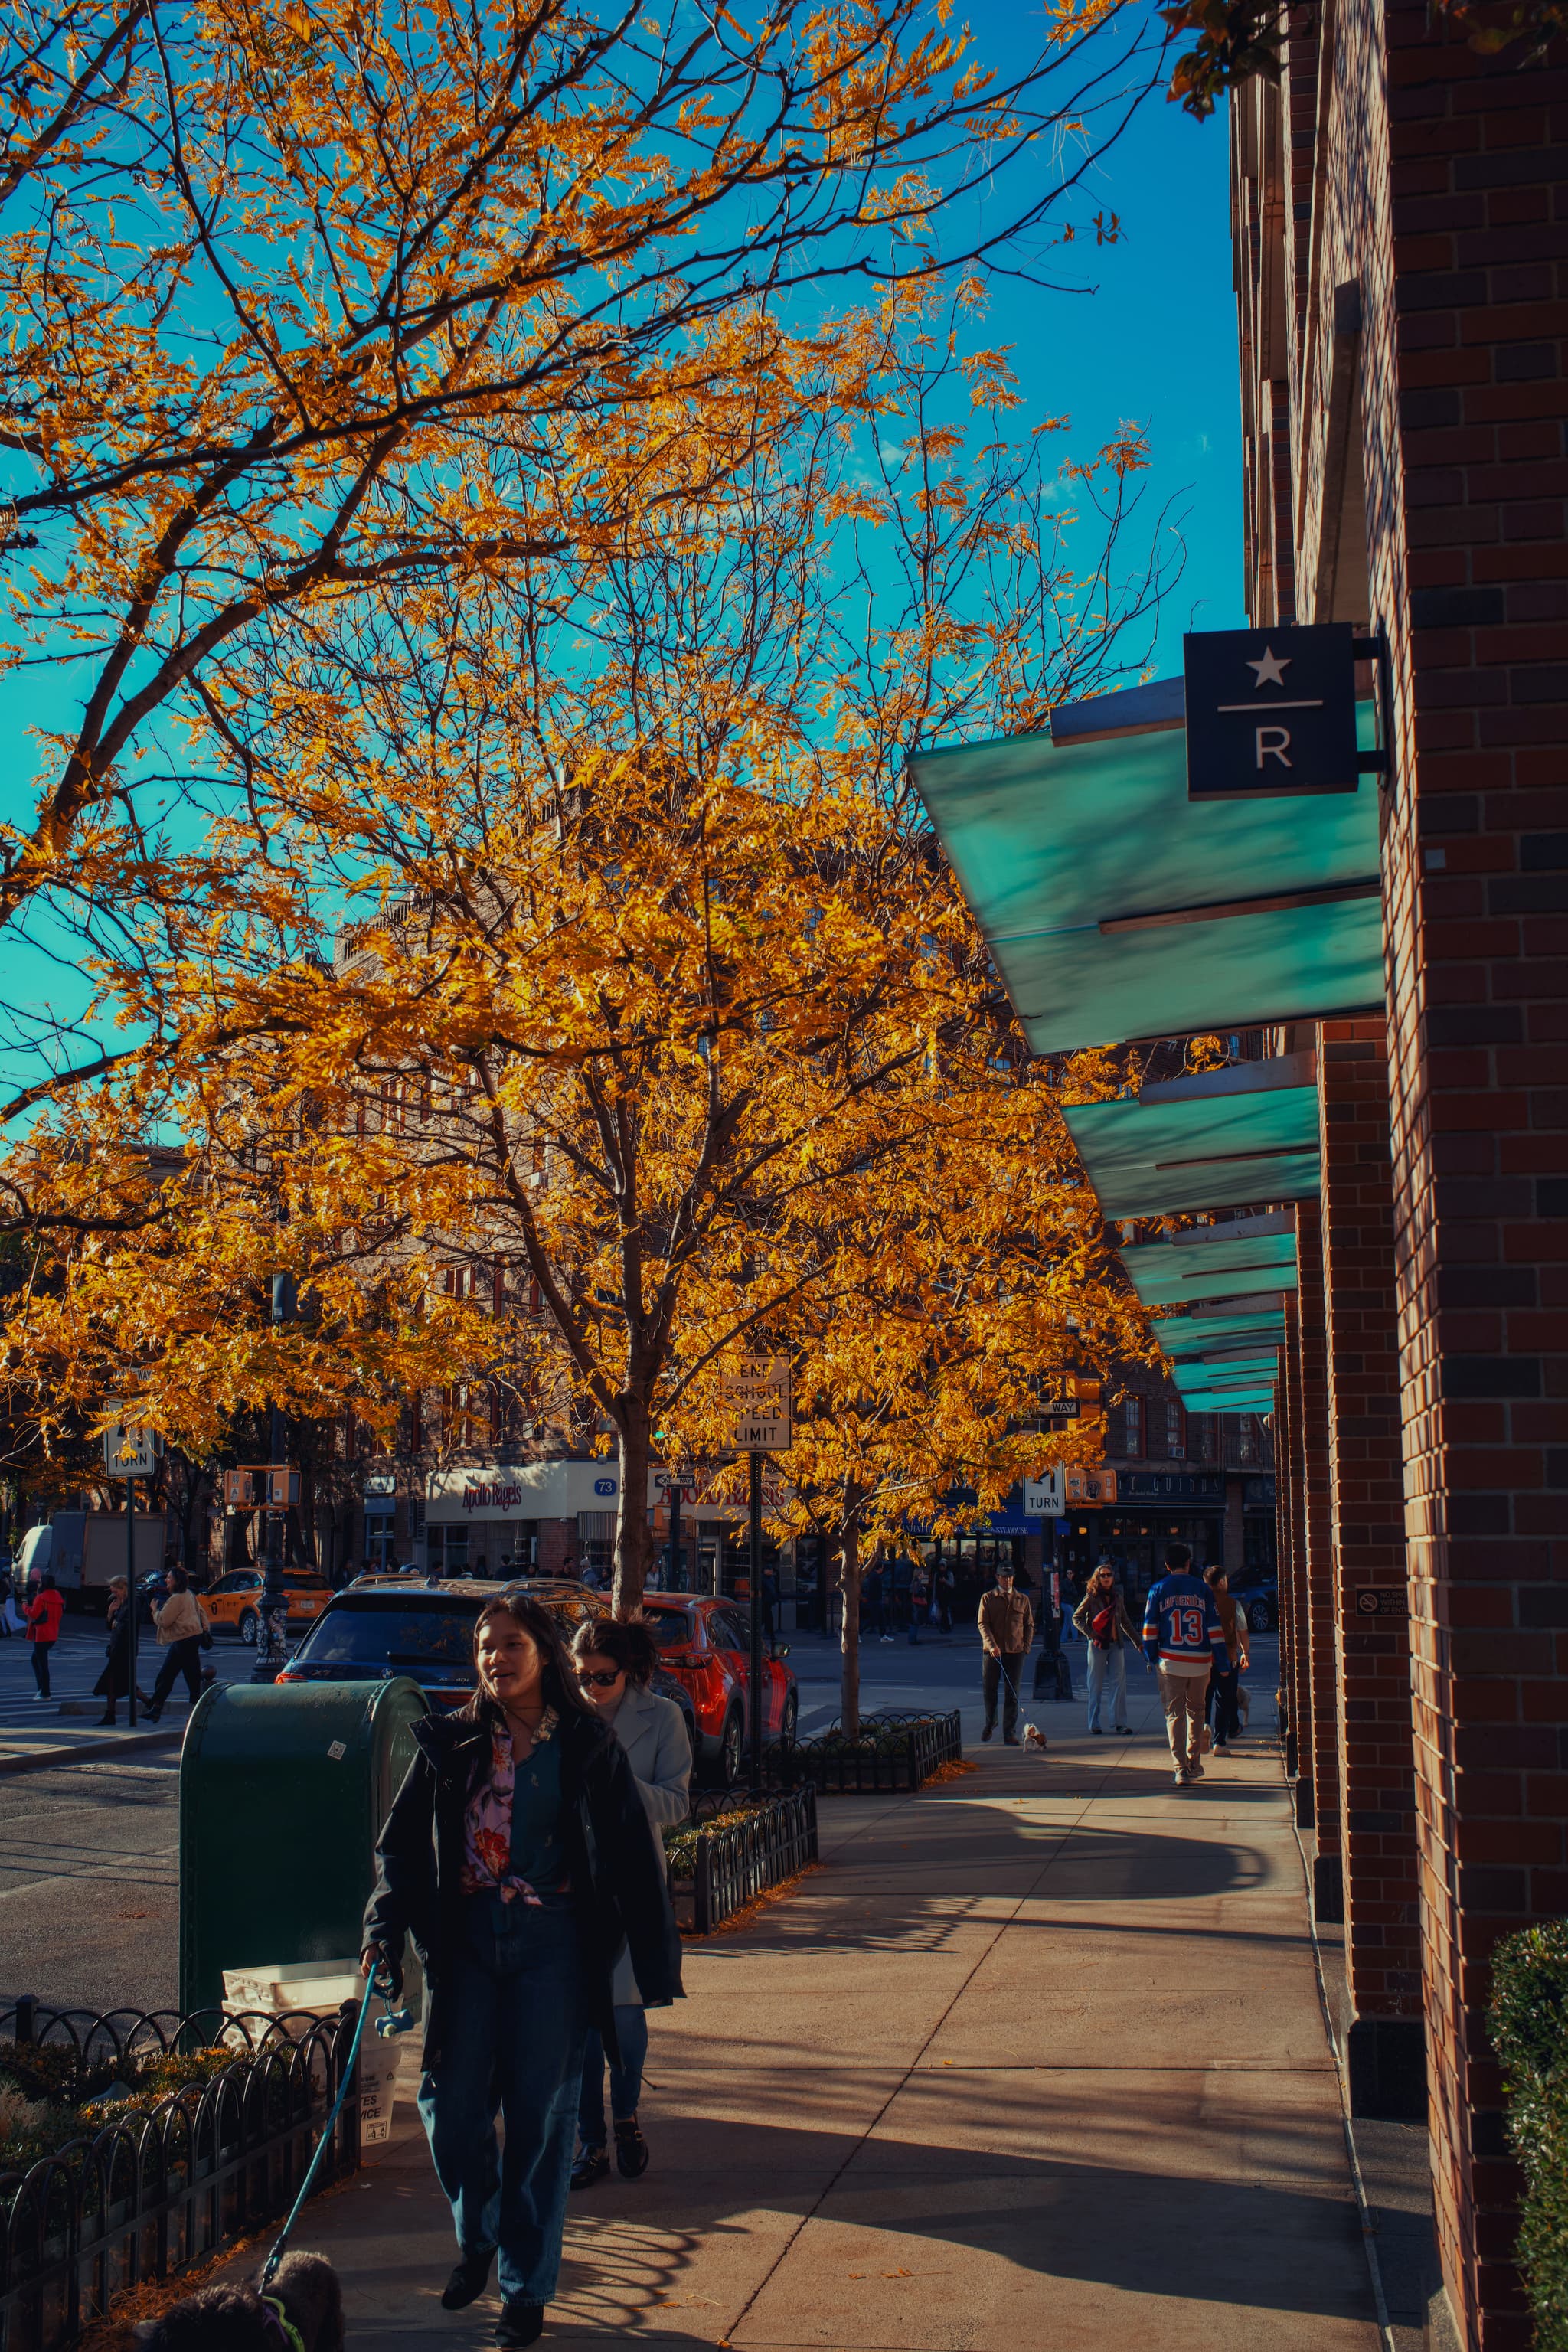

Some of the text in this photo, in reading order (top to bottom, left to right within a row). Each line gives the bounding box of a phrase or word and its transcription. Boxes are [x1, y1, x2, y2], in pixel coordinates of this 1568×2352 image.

[1255, 726, 1293, 769] R
[1052, 1403, 1074, 1413] WAY
[733, 1427, 777, 1441] LIMIT
[598, 1481, 612, 1493] 73
[462, 1480, 522, 1514] Apollo Bagels
[1028, 1497, 1060, 1508] TURN
[1168, 1608, 1203, 1646] 13
